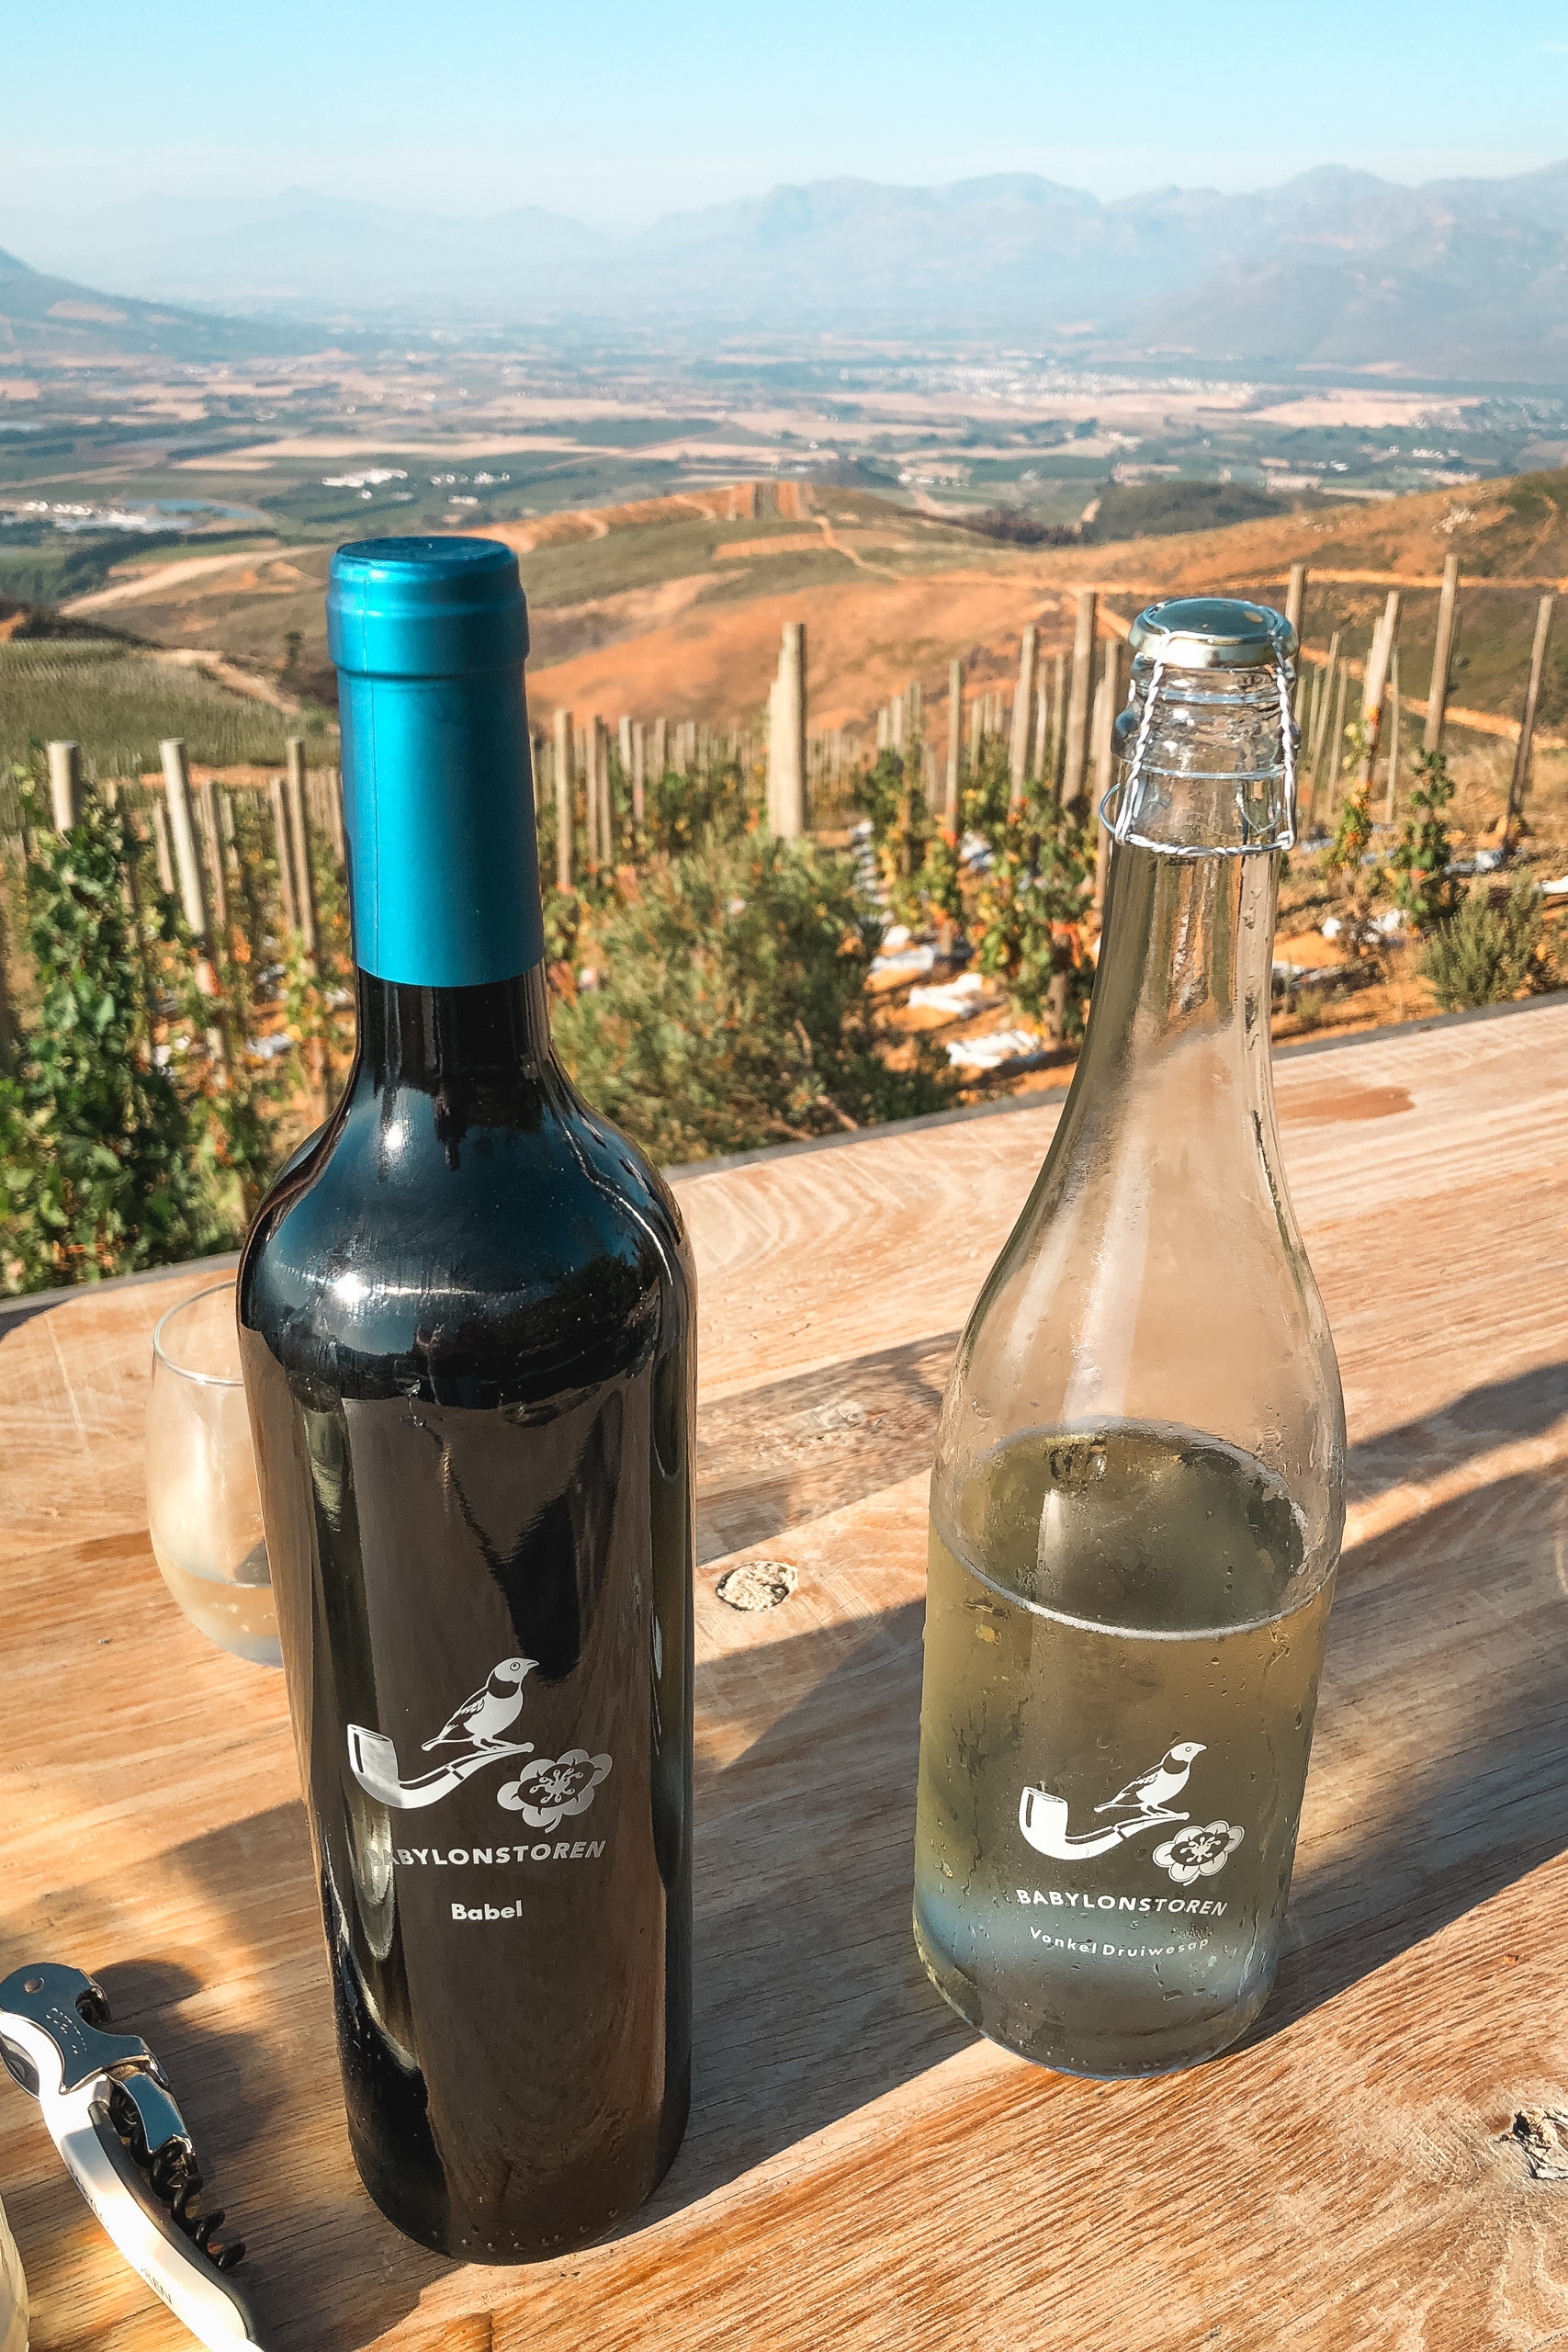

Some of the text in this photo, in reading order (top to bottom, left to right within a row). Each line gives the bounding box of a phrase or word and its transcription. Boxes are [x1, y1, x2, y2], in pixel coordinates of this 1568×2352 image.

[366, 1840, 606, 1867] BABYLONSTOREN
[451, 1899, 523, 1921] Babel
[1016, 1889, 1228, 1917] BABYLONSTOREN
[1029, 1926, 1209, 1957] Vonkel Druiwesap
